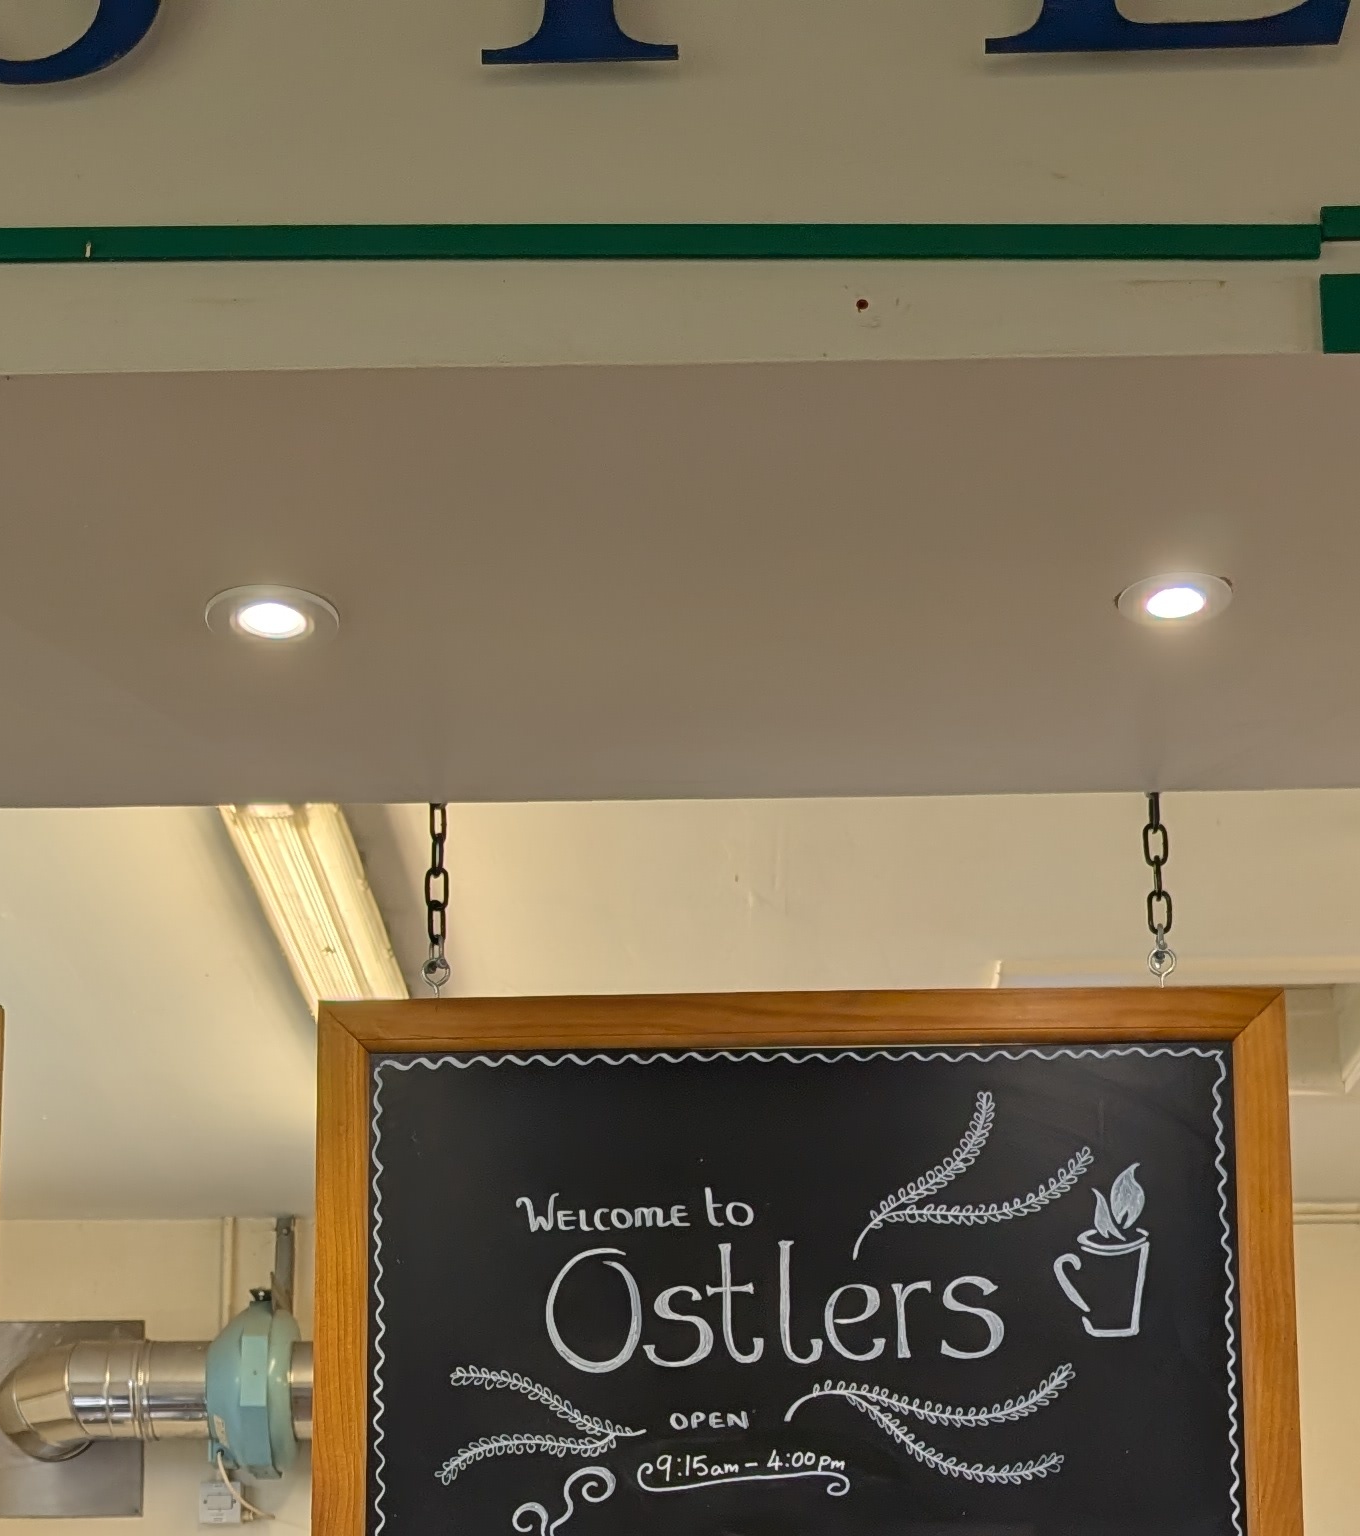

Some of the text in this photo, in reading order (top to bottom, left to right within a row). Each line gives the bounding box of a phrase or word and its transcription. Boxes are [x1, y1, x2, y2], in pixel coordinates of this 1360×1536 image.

[704, 1187, 754, 1227] to
[546, 1240, 1005, 1373] Ostlers
[670, 1411, 749, 1430] OPEN
[656, 1455, 739, 1481] 9:15am
